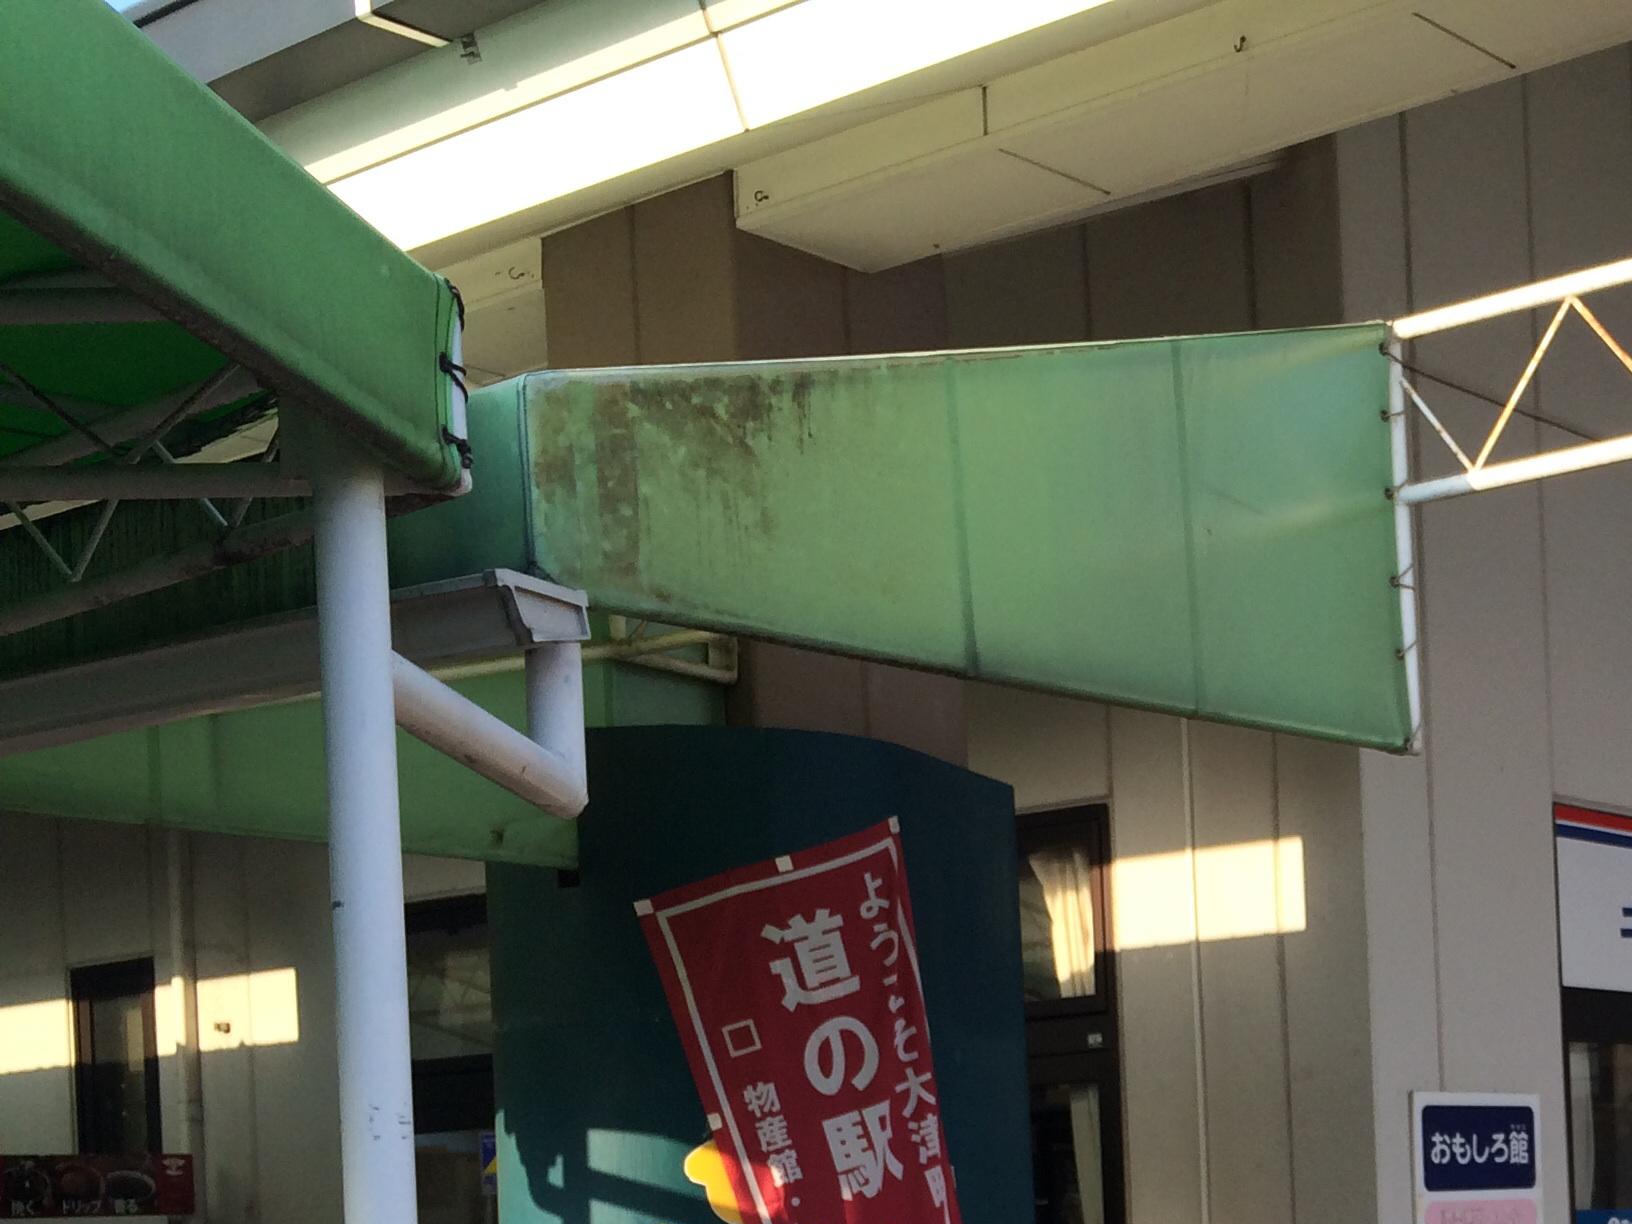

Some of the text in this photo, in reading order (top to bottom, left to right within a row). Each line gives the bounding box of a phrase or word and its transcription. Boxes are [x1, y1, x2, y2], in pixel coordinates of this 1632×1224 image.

[1430, 1131, 1529, 1165] おもしろ館
